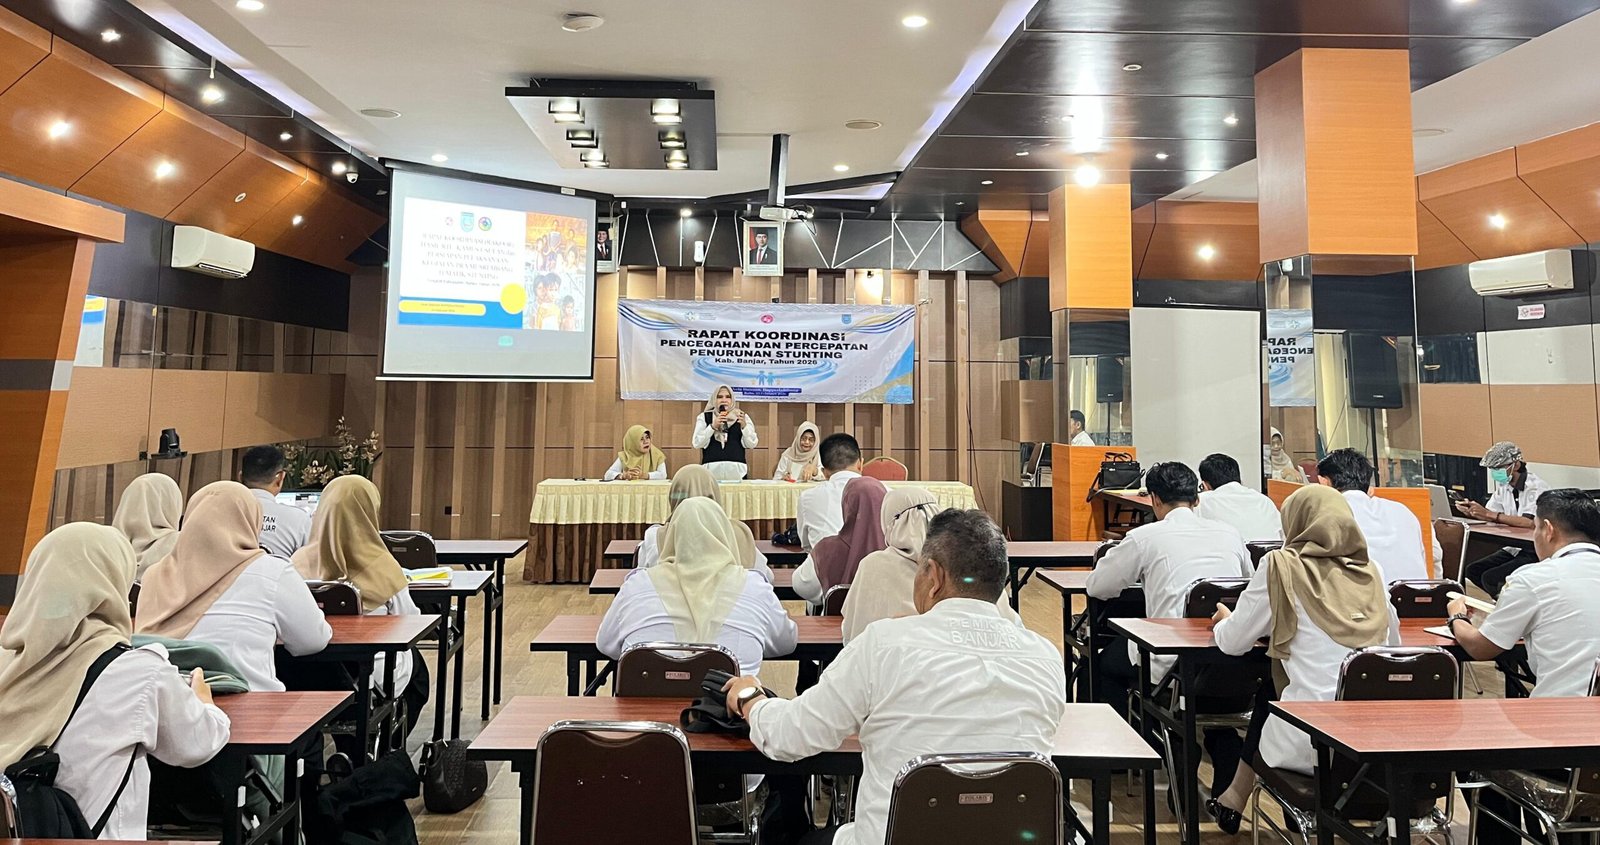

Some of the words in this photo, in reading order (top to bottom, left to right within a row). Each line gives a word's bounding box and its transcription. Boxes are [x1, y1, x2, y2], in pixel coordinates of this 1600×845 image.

[688, 329, 739, 339] RAPAT
[745, 331, 846, 341] KOORDINASI
[660, 339, 750, 349] PENCEGAHAN
[754, 341, 781, 349] DAN
[785, 342, 868, 351] PERCEPATAN
[689, 349, 771, 358] PENURUNAN
[775, 350, 843, 359] STUNTING
[951, 630, 1021, 649] BANJAR
